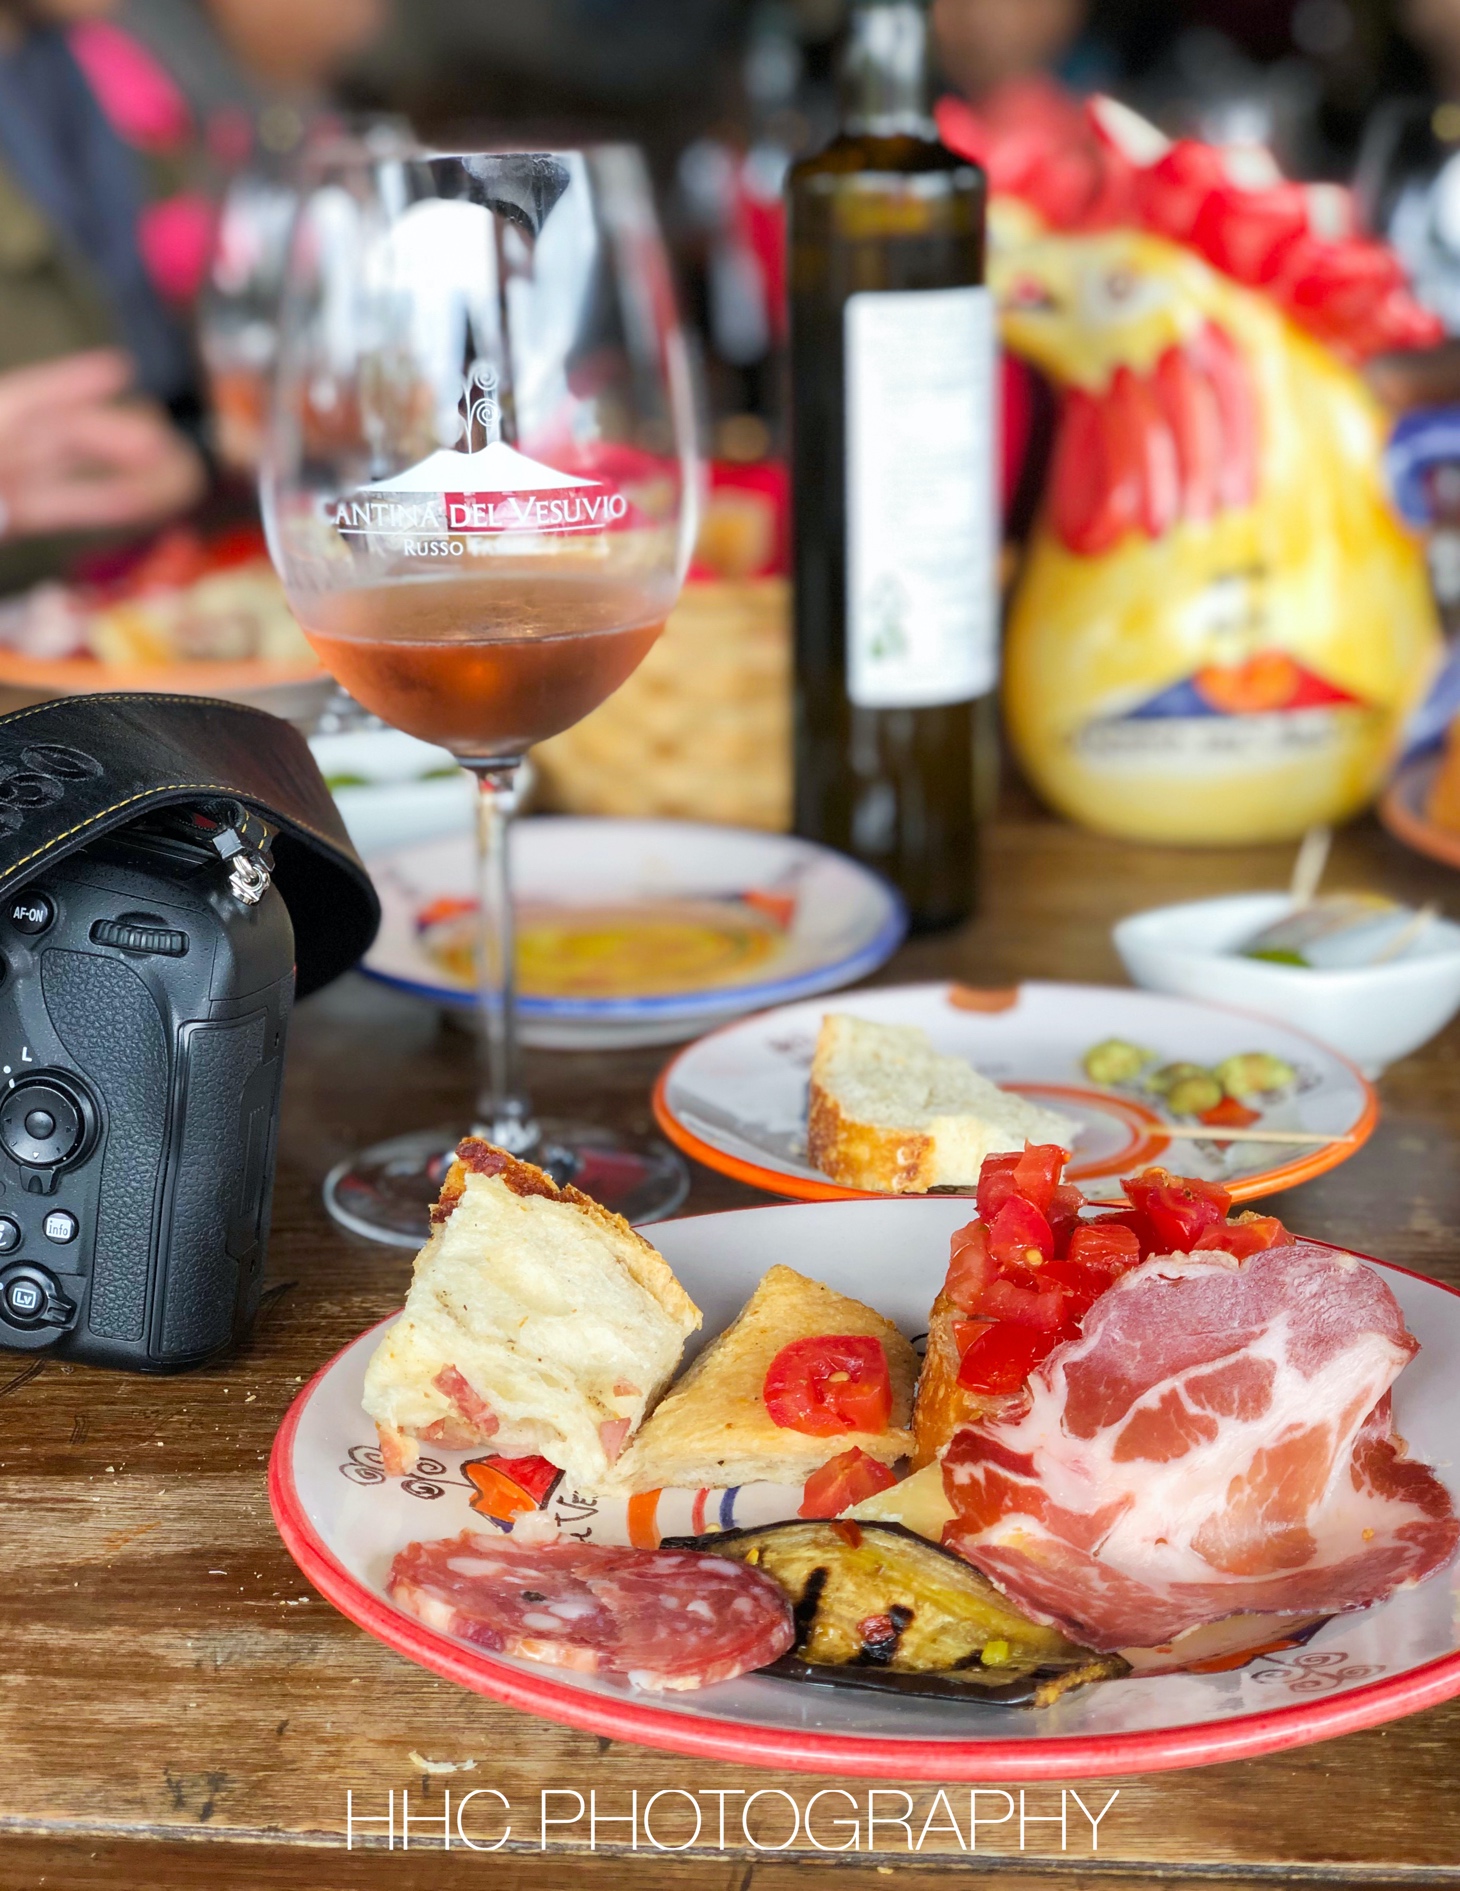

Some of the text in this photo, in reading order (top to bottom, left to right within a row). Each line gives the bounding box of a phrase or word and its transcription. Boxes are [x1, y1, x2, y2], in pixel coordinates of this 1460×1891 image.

[449, 503, 501, 528] DEL
[507, 494, 627, 527] VESUVIO
[404, 538, 464, 556] RUSSO
[13, 906, 44, 922] AF-ON
[22, 1046, 32, 1062] L
